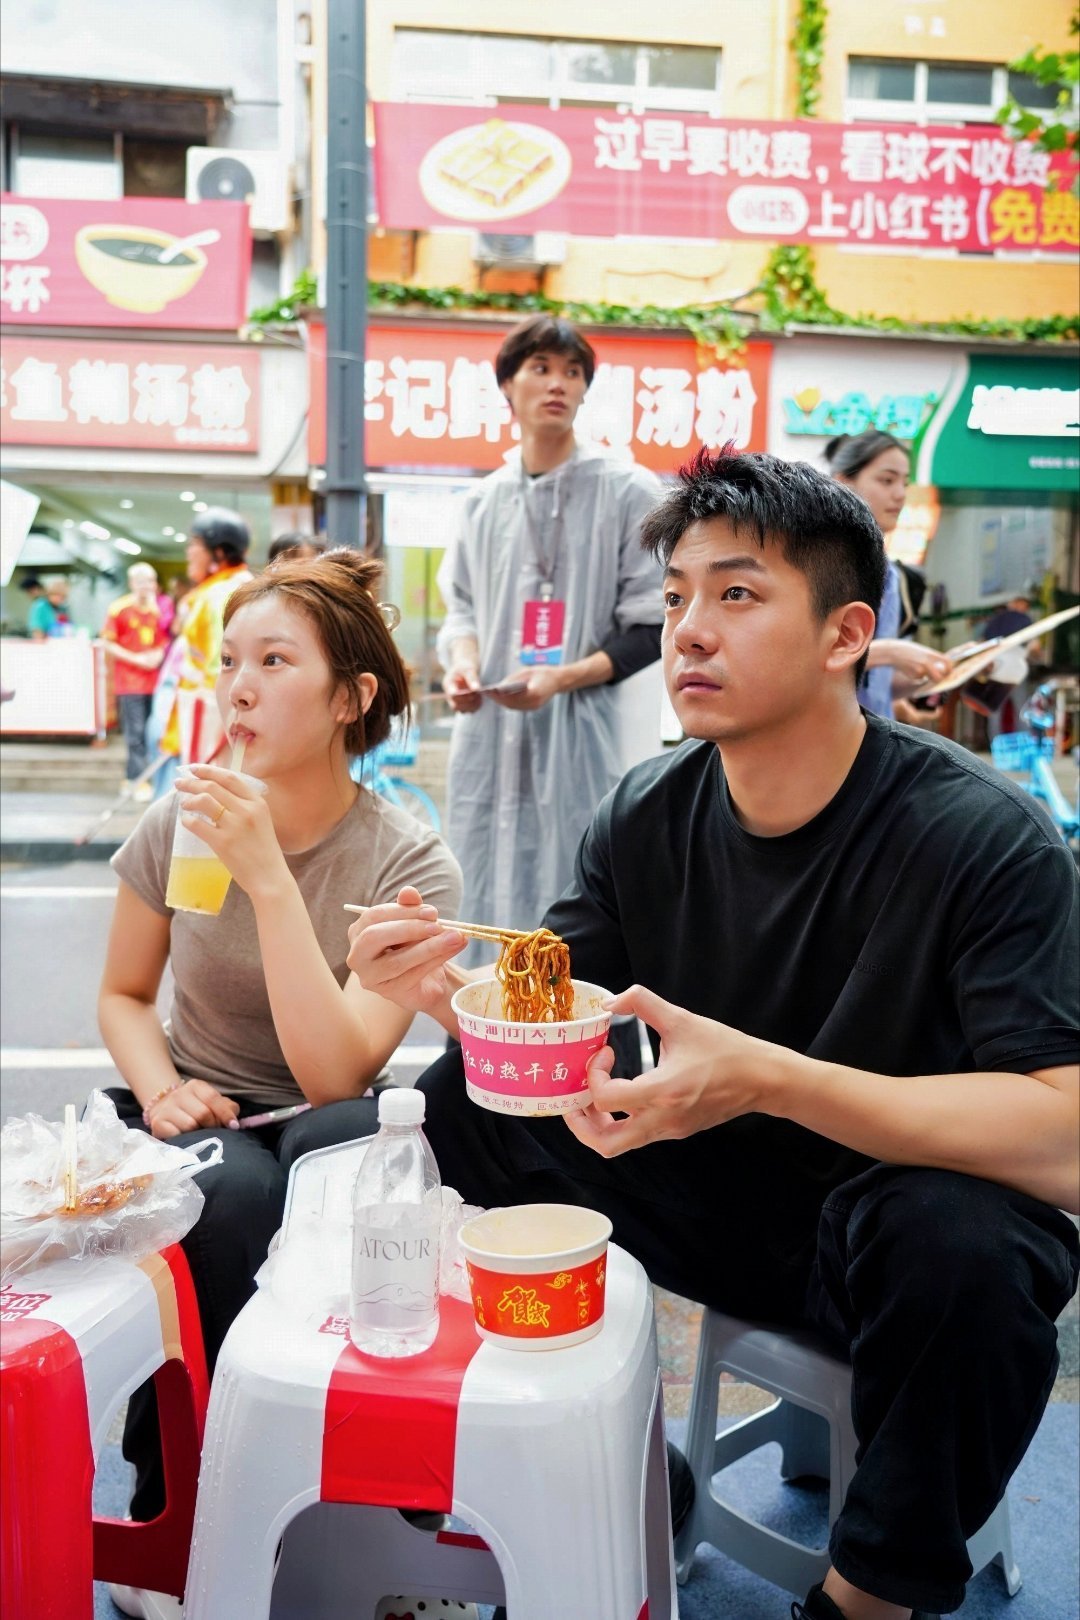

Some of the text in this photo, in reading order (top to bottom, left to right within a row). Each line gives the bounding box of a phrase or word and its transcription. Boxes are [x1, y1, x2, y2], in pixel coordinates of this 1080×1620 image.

[1, 357, 251, 429] 鱼糊汤粉
[365, 356, 757, 450] 记鲜糊汤粉
[465, 1048, 569, 1086] 红油热干面
[359, 1237, 431, 1261] ATOUR
